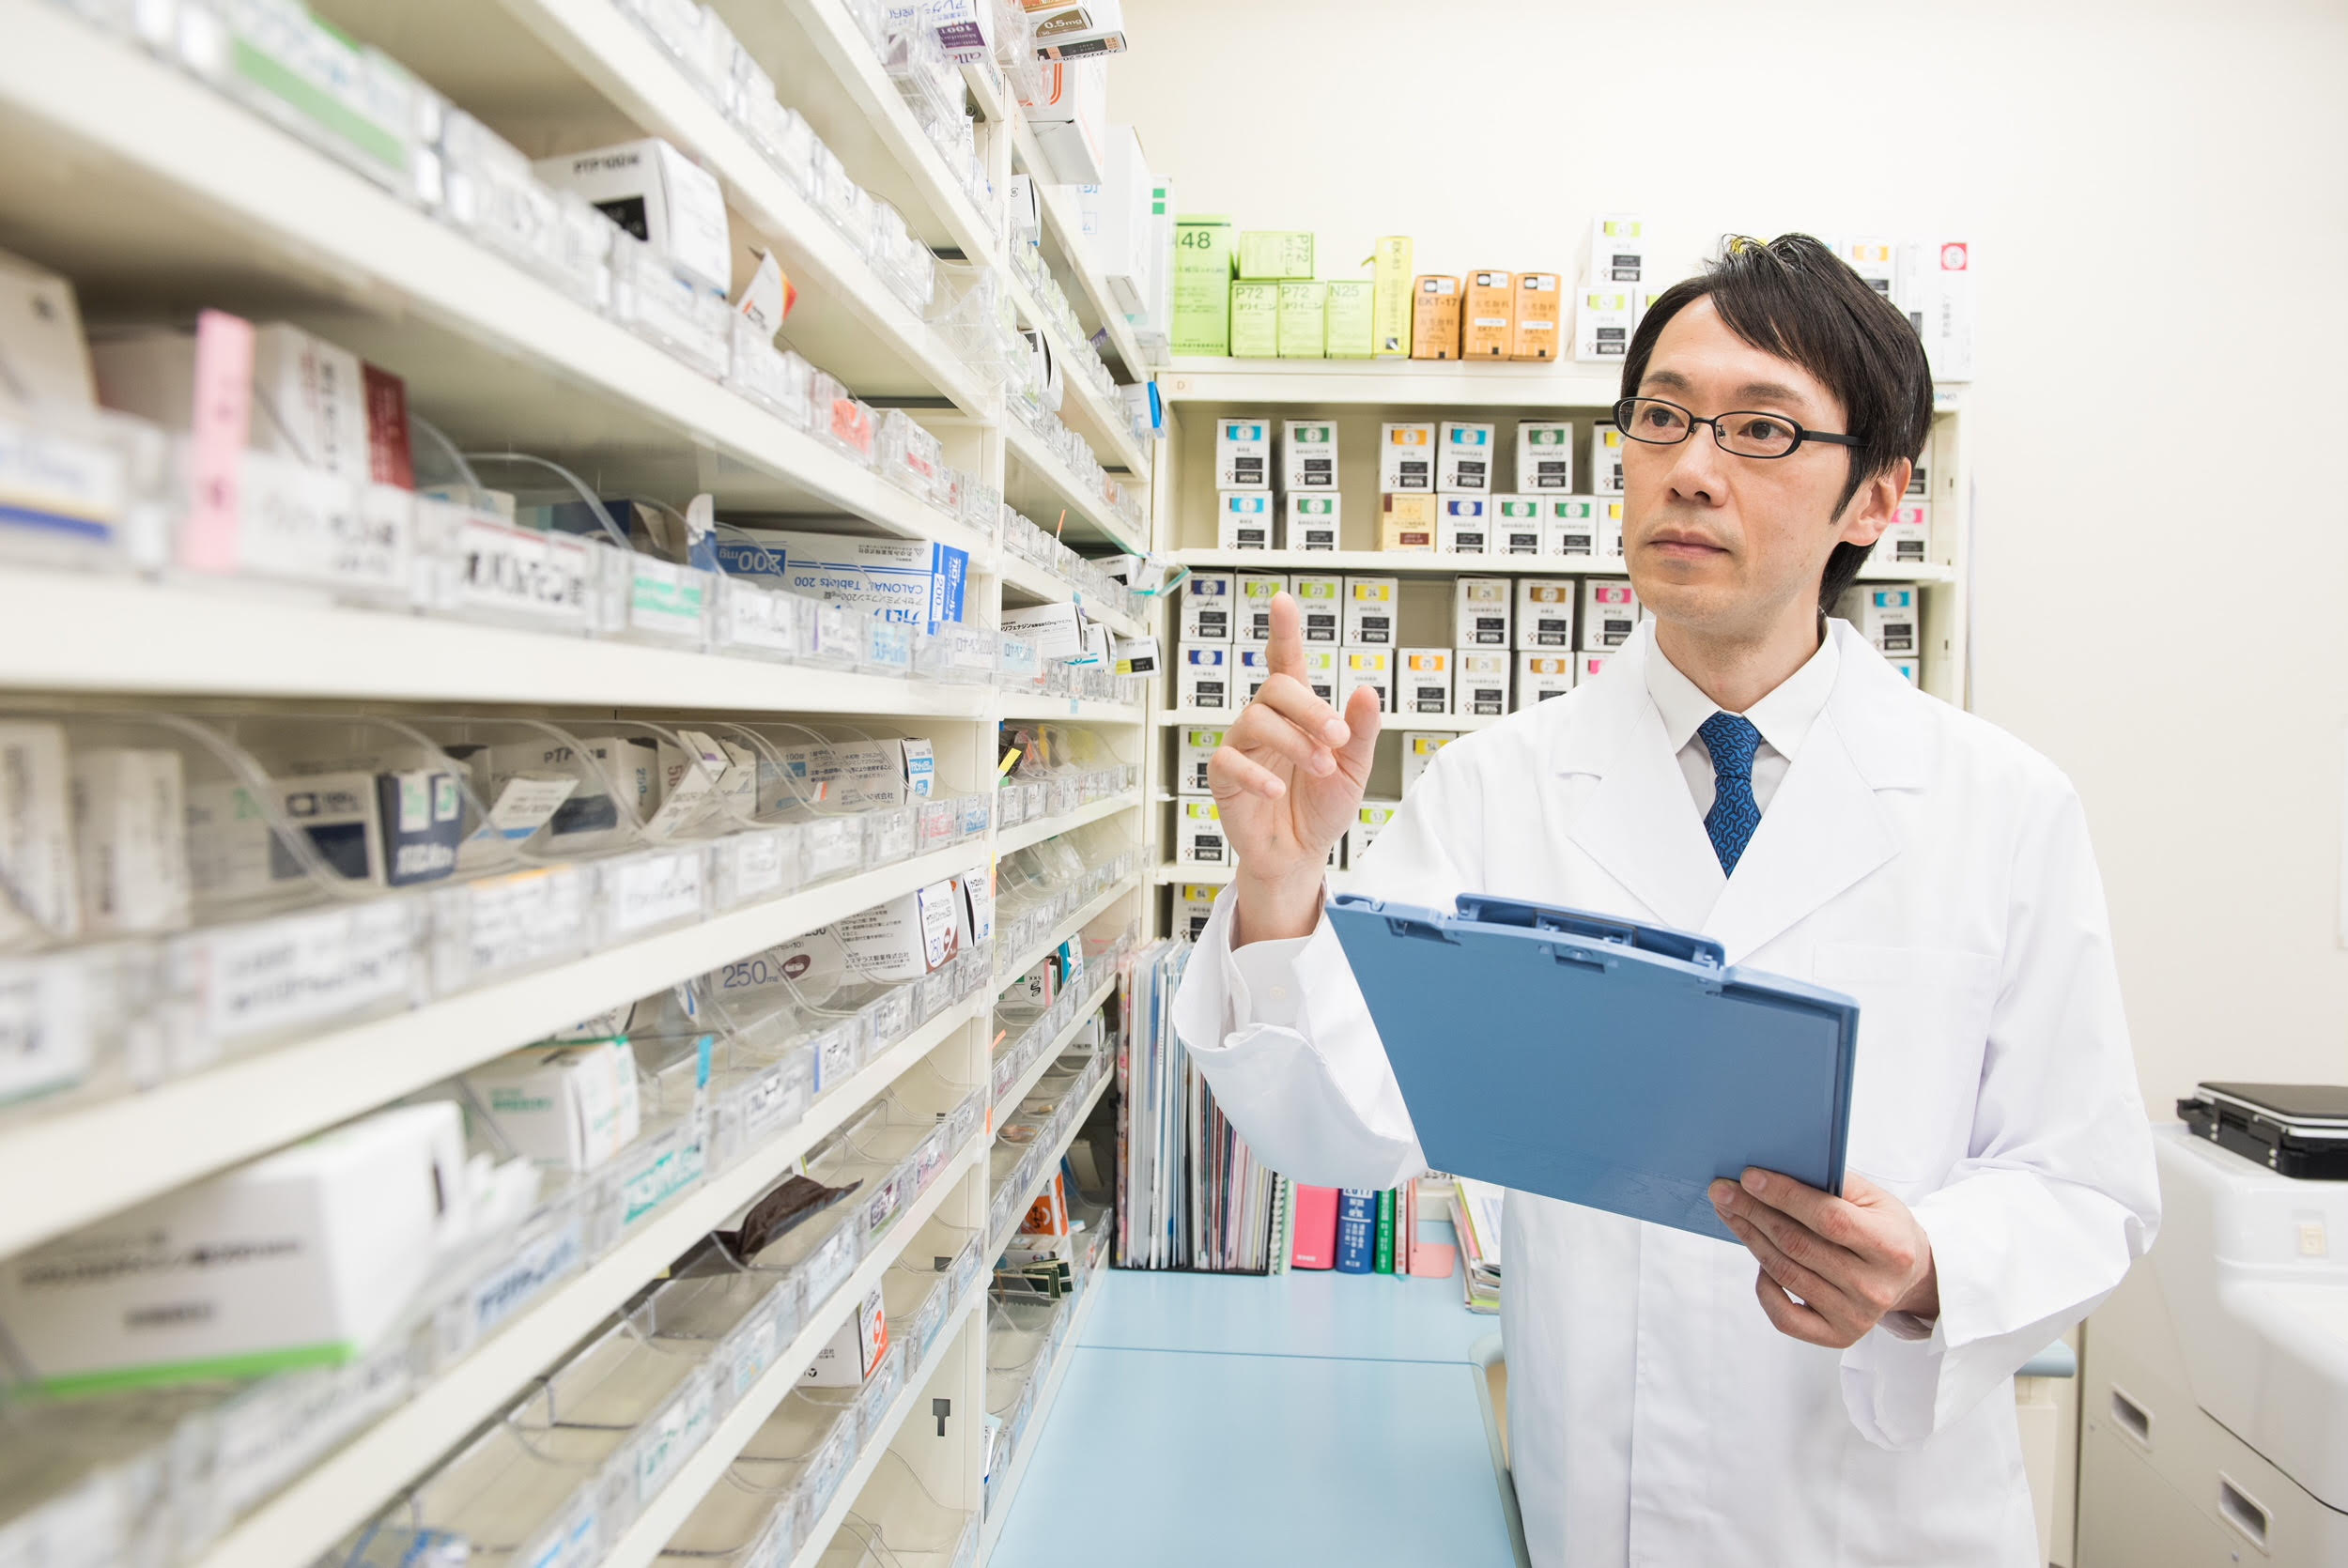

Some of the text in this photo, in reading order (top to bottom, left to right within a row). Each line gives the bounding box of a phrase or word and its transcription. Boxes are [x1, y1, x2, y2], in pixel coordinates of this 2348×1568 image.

[1044, 19, 1083, 29] 0.5mg
[1236, 286, 1264, 300] P72
[1281, 285, 1310, 299] P72
[1331, 284, 1360, 297] N25
[1418, 297, 1458, 308] EKT-17
[718, 547, 782, 571] 200mg
[794, 576, 817, 588] 200
